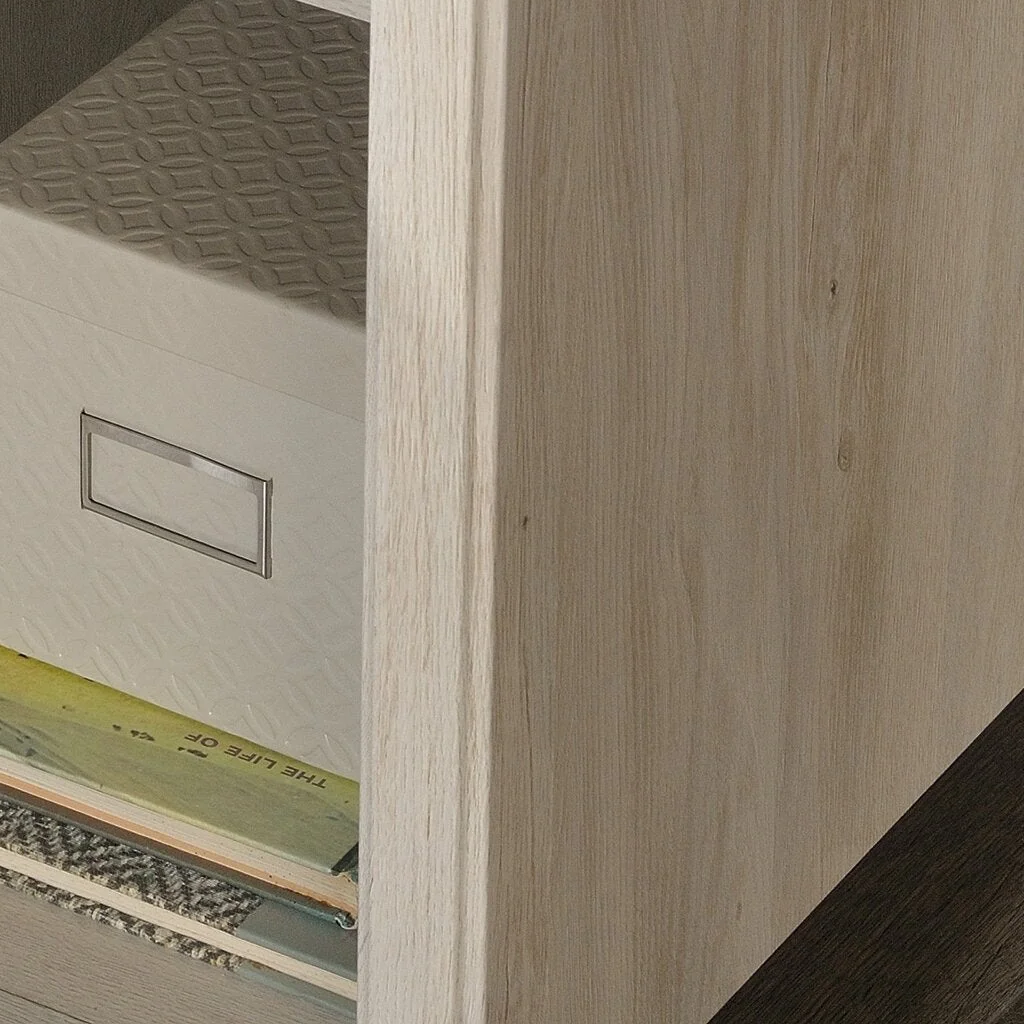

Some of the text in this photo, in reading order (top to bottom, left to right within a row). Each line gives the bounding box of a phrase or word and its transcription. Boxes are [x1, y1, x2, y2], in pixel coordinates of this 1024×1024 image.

[183, 733, 328, 789] THE LIFE OF
